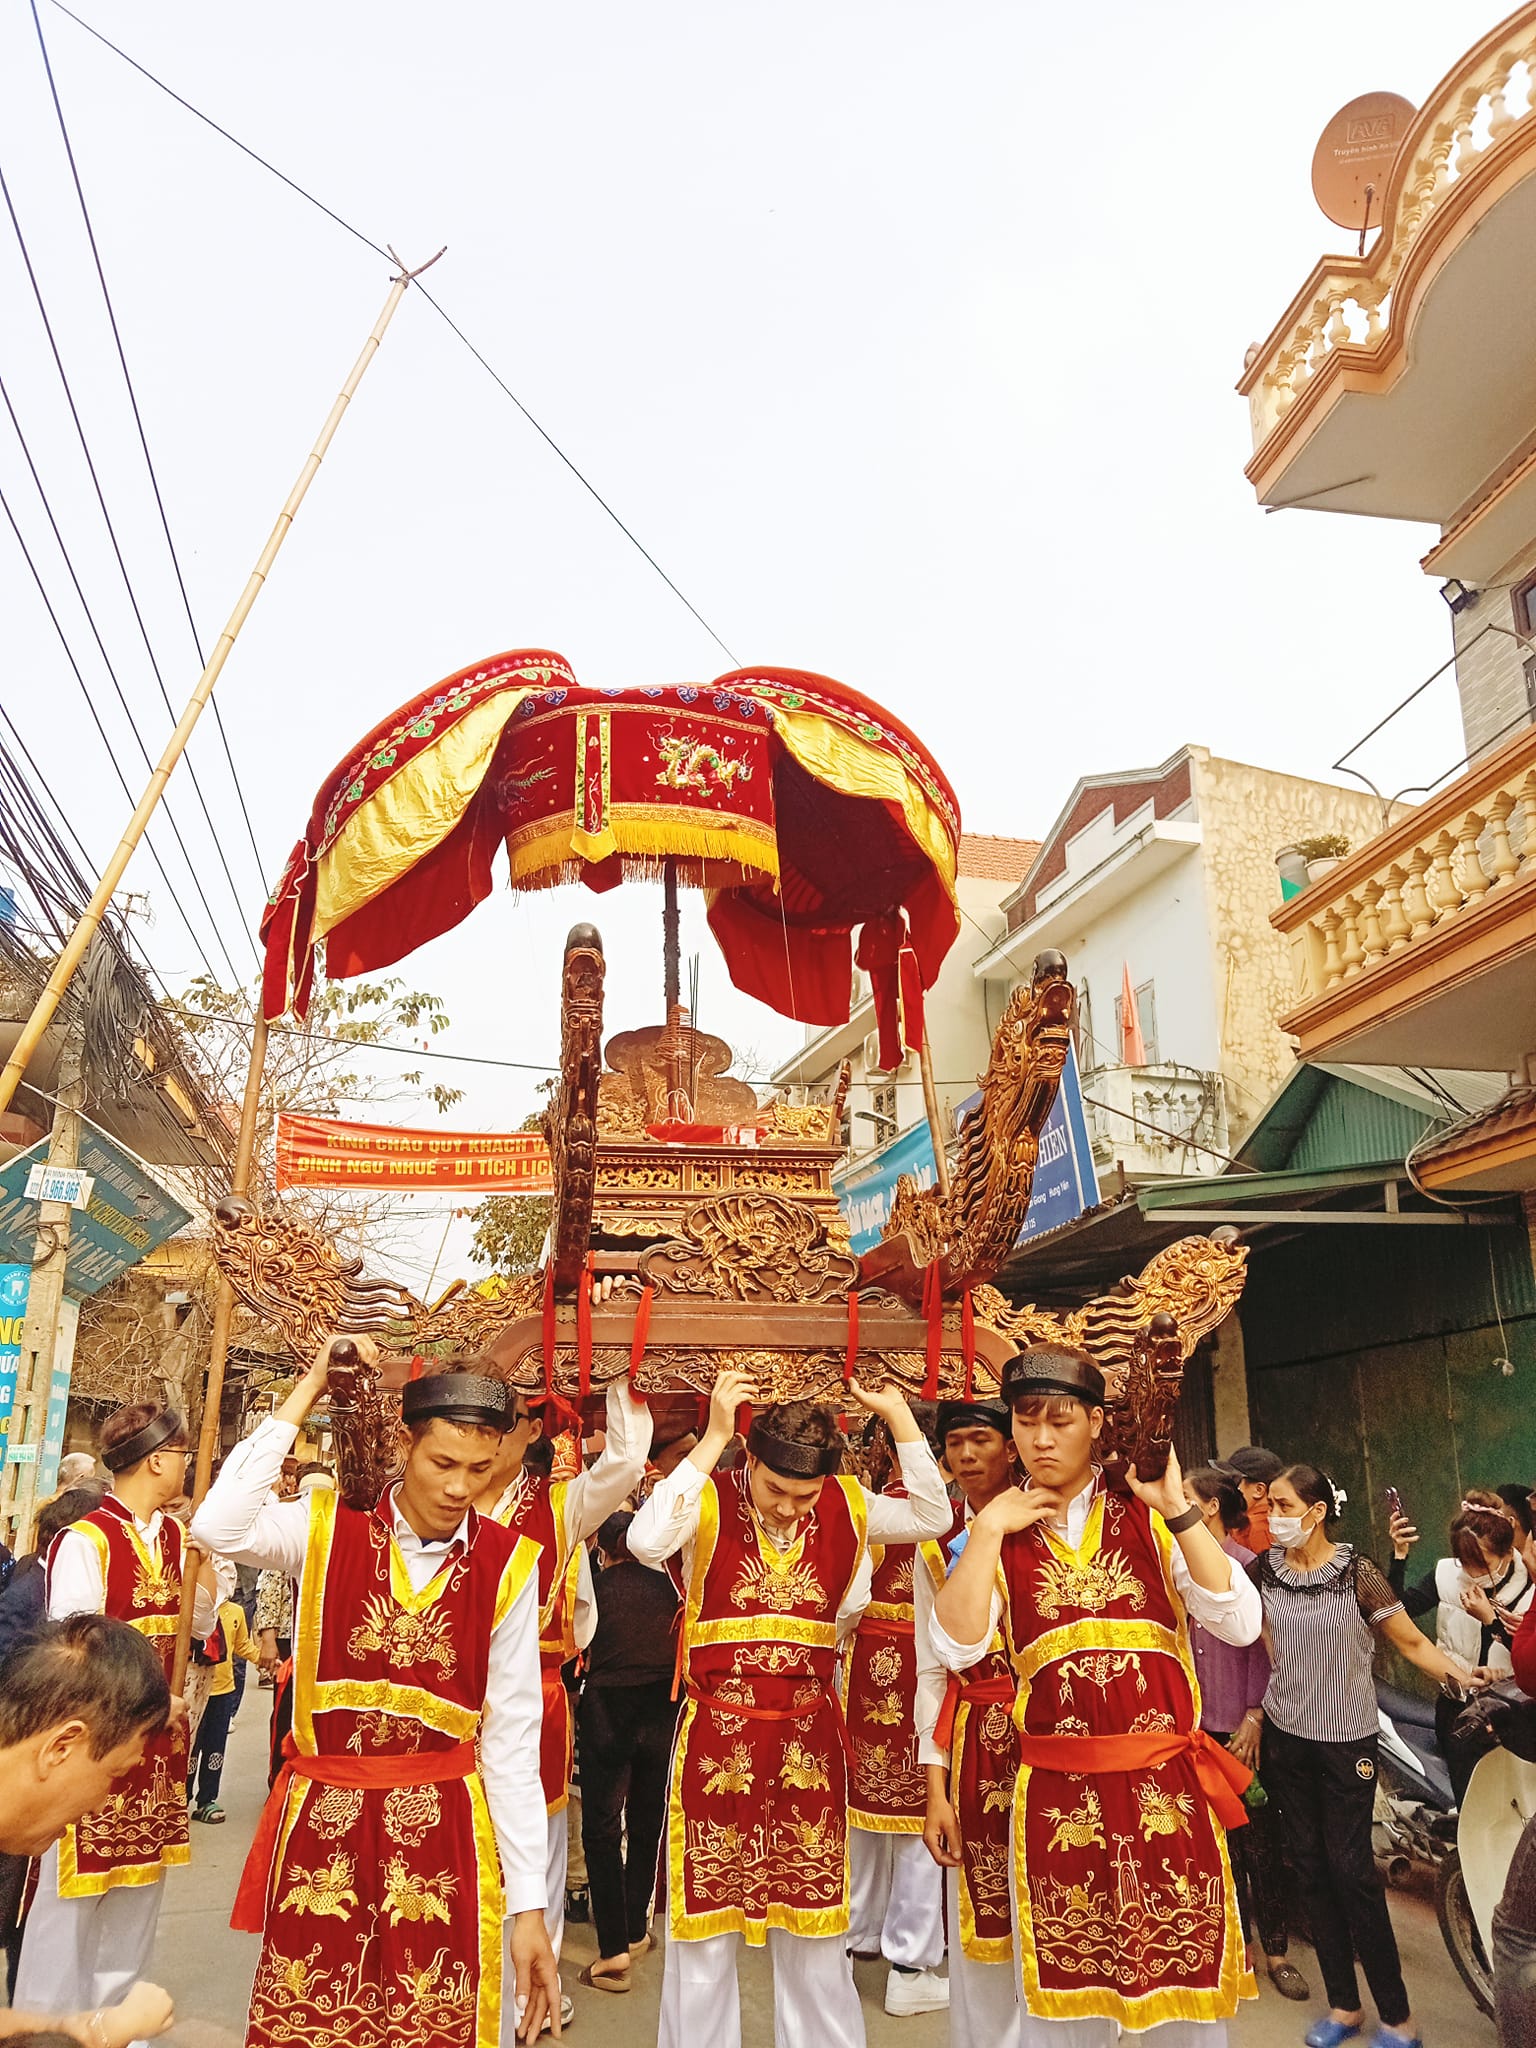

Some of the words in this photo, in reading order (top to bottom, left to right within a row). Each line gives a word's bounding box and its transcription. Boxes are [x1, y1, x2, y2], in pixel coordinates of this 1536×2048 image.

[327, 1133, 370, 1150] KÍNH
[375, 1136, 423, 1152] CHÀO
[297, 1155, 341, 1173] ĐÌNH
[347, 1159, 384, 1174] NGU
[455, 1160, 472, 1175] DI
[478, 1158, 516, 1176] TÍCH
